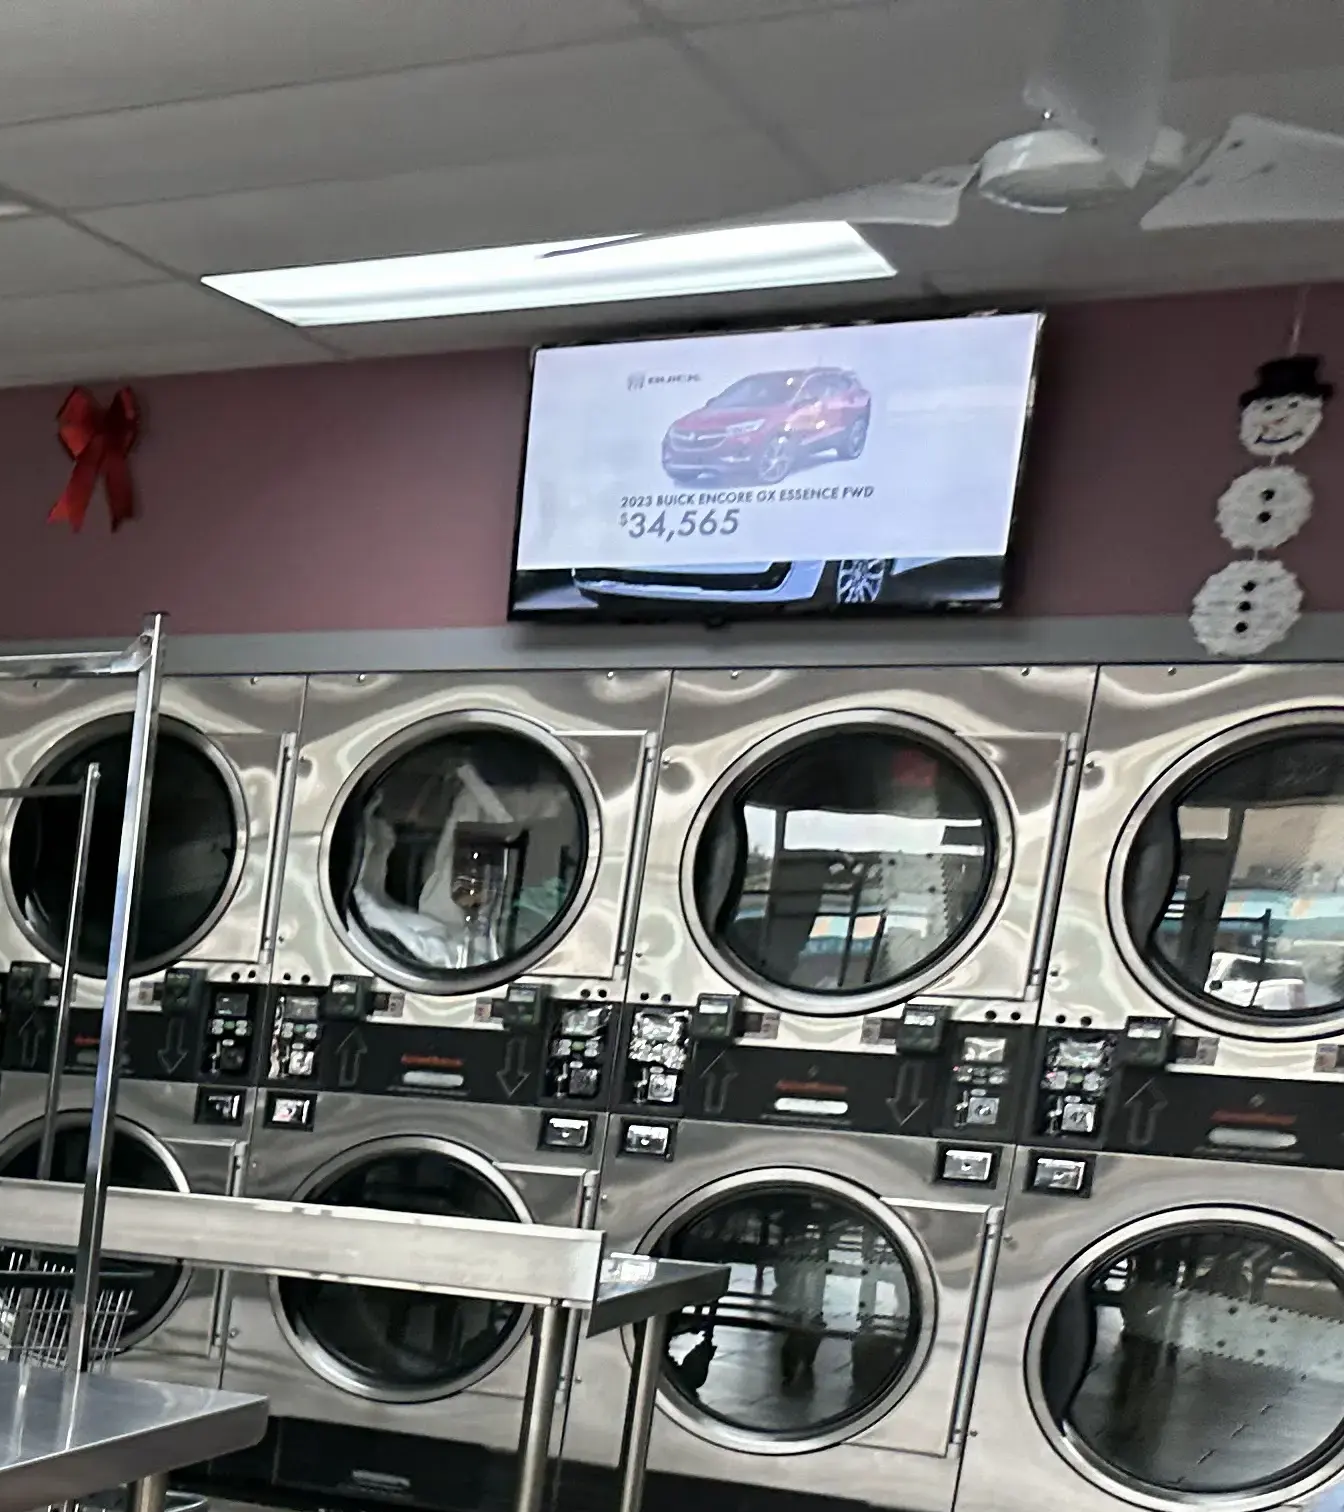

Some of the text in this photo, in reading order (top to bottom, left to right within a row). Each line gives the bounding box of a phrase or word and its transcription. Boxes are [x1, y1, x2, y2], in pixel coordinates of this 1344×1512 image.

[620, 485, 876, 508] 2023 BUICK ENCORE GX ESSENCE FWD
[618, 507, 741, 542] $34,565
